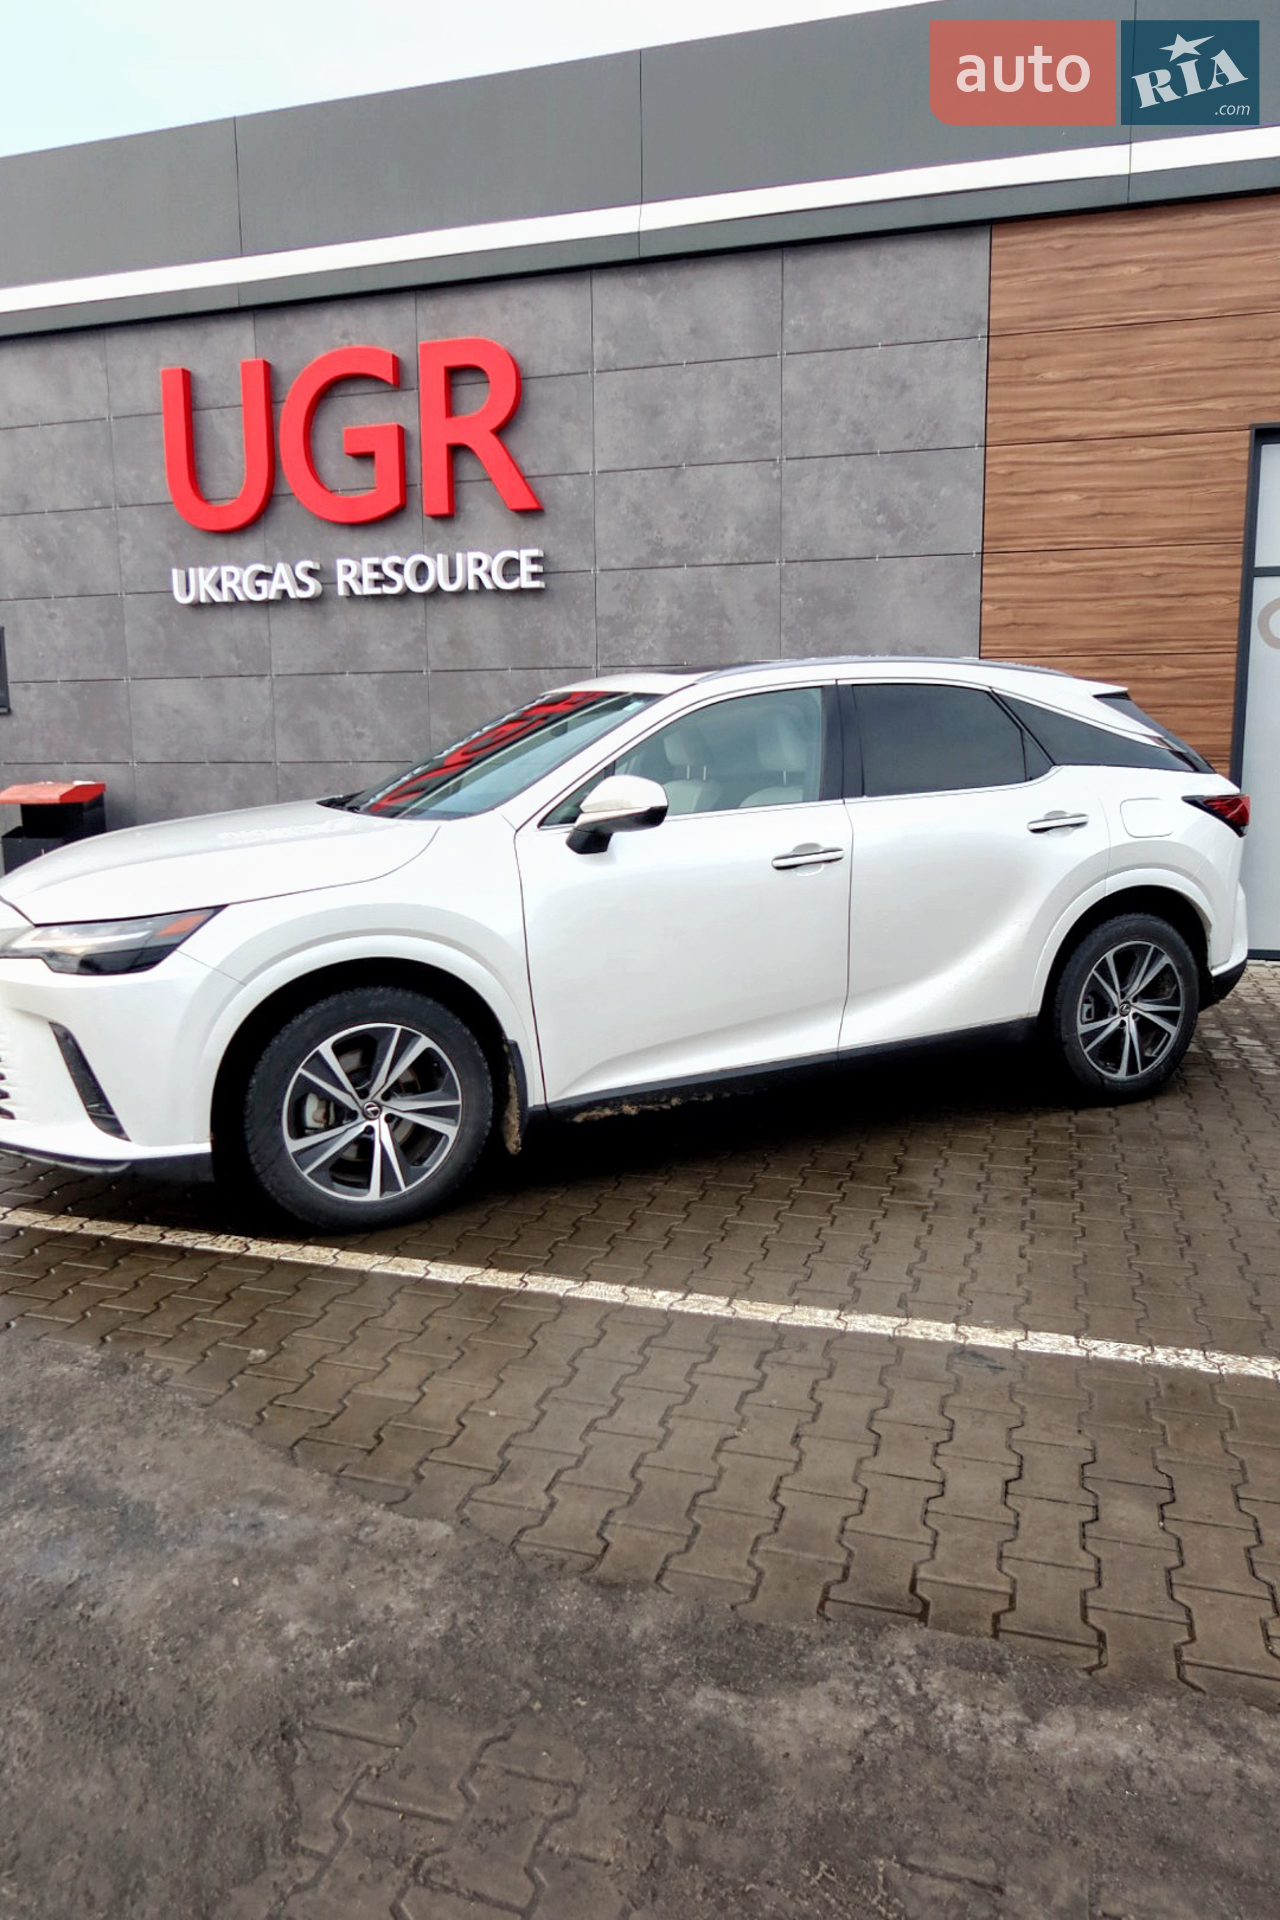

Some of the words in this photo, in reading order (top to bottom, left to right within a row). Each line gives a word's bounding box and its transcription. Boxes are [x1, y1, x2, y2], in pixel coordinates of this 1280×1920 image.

[161, 337, 543, 532] UGR
[171, 560, 321, 604] UKRGAS
[337, 549, 545, 596] RESOURCE
